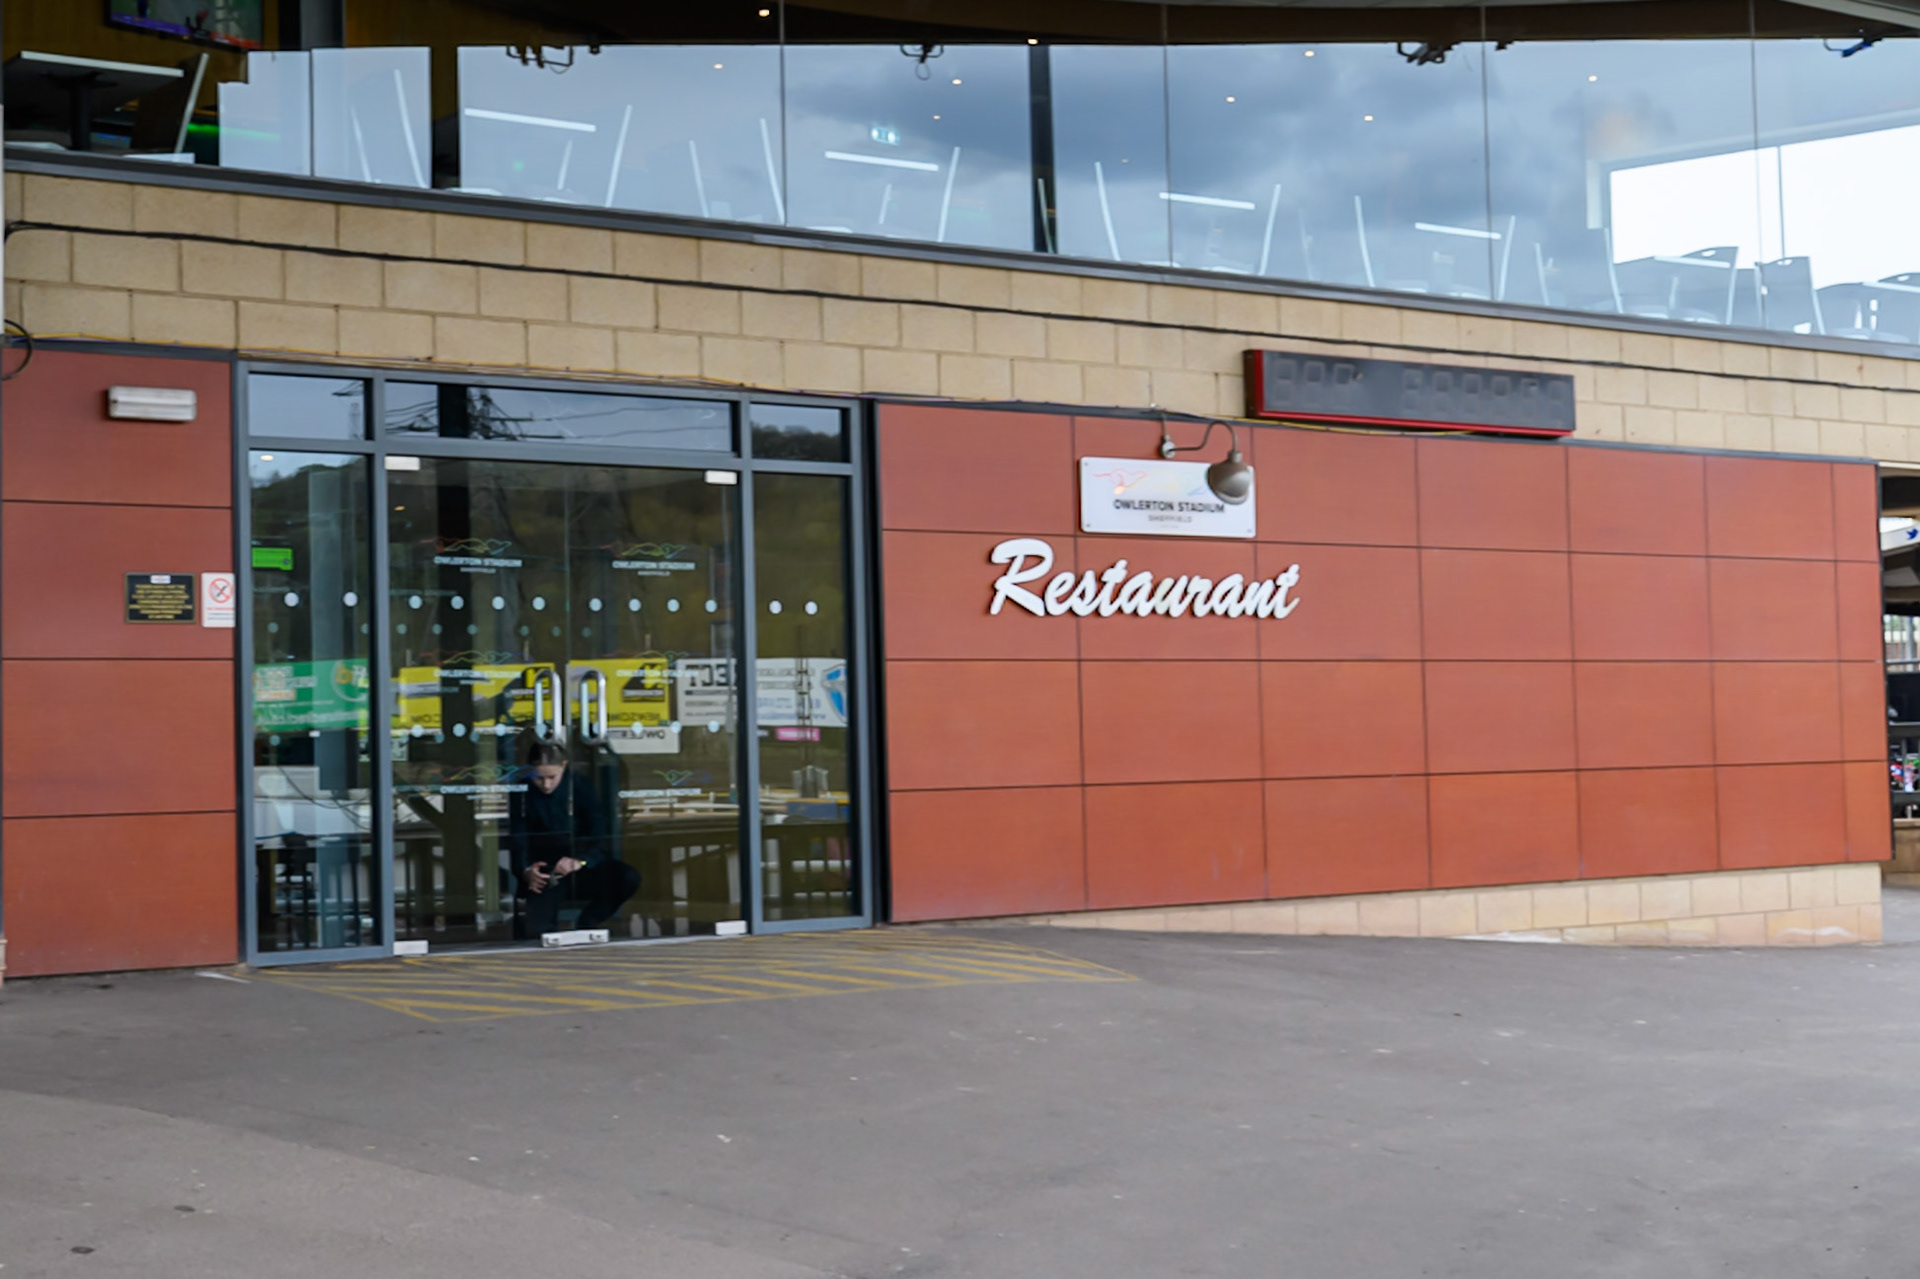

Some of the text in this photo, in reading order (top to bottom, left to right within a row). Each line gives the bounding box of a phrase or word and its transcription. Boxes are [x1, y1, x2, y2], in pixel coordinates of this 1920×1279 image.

[1113, 499, 1226, 513] OWLERTON STADIUM
[990, 538, 1300, 618] Restaurant
